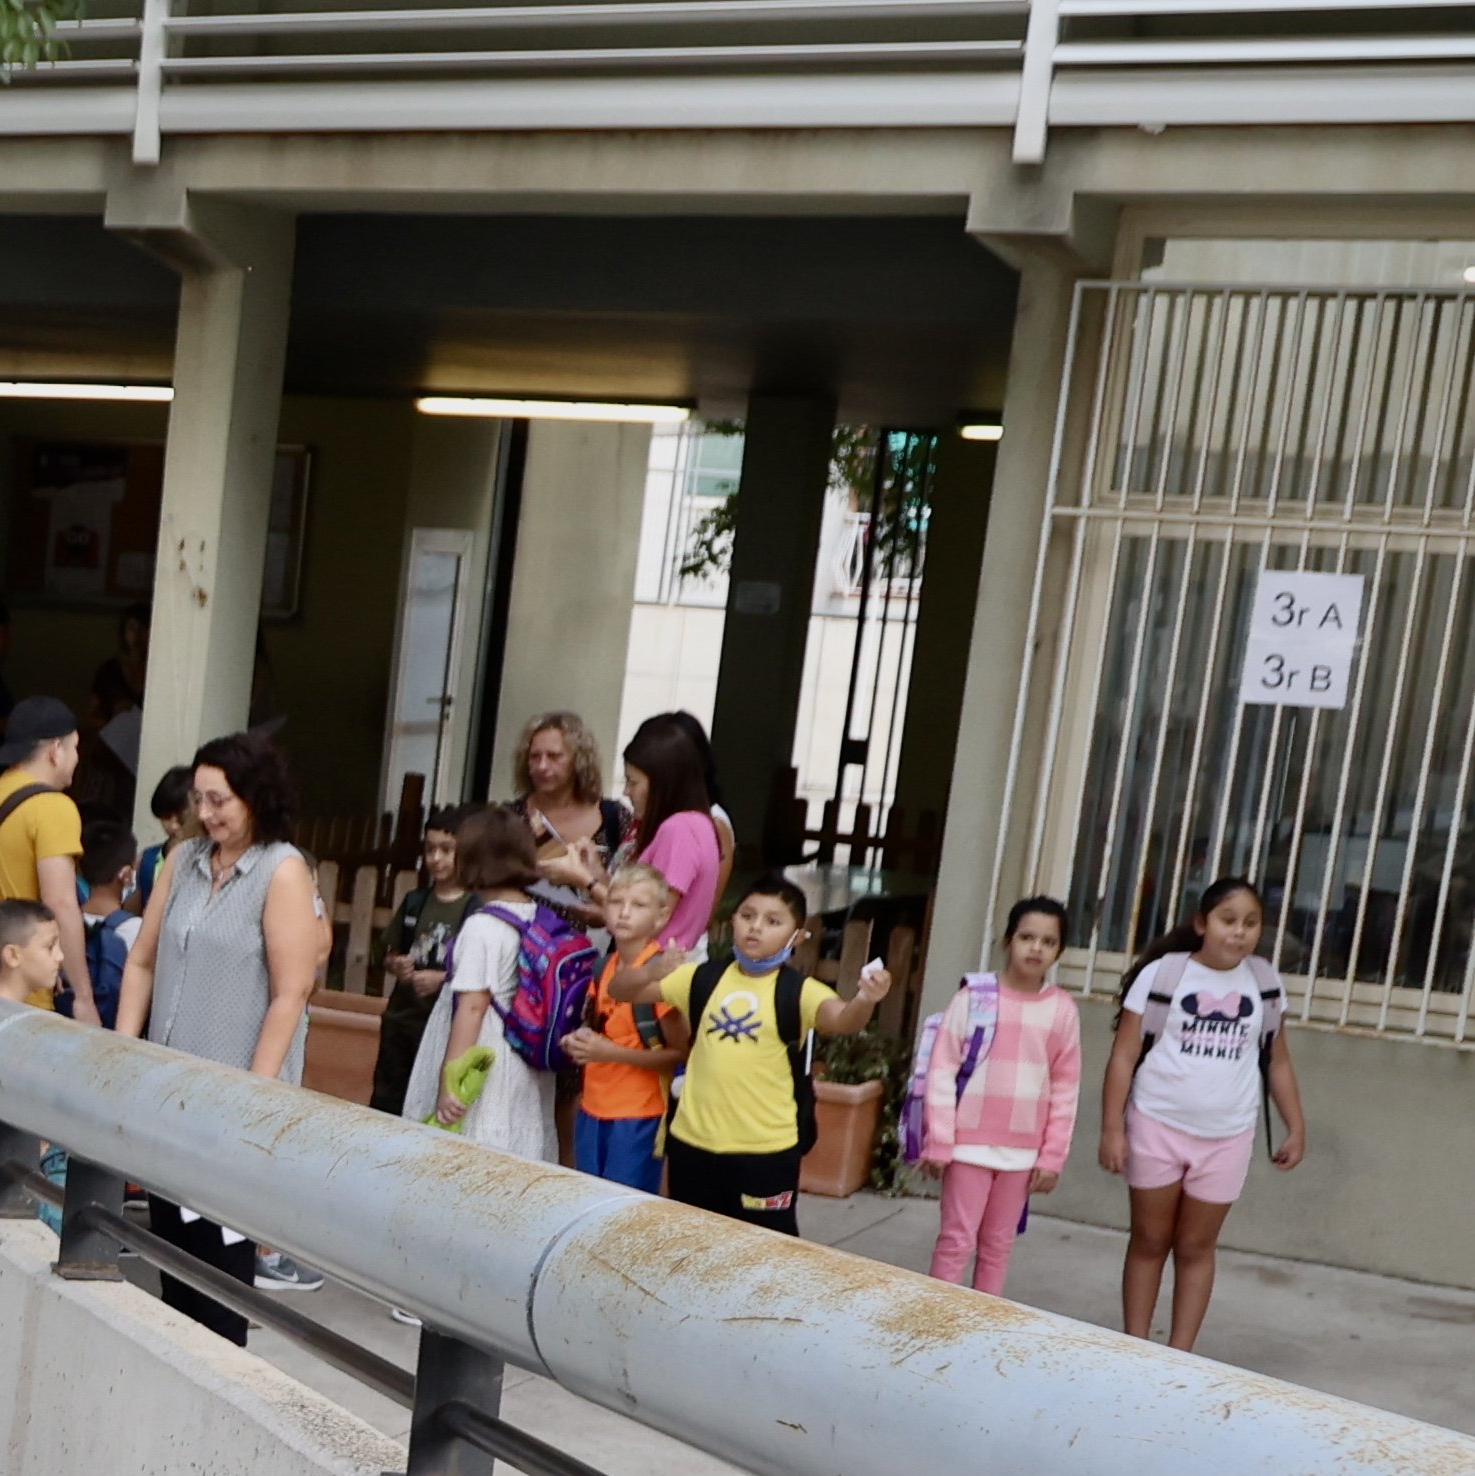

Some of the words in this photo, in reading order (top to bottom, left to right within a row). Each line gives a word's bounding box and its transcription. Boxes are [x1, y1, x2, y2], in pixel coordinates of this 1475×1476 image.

[1272, 591, 1310, 628] 3r
[1318, 602, 1343, 629] A
[1261, 653, 1300, 691] 3r
[1310, 664, 1332, 692] B
